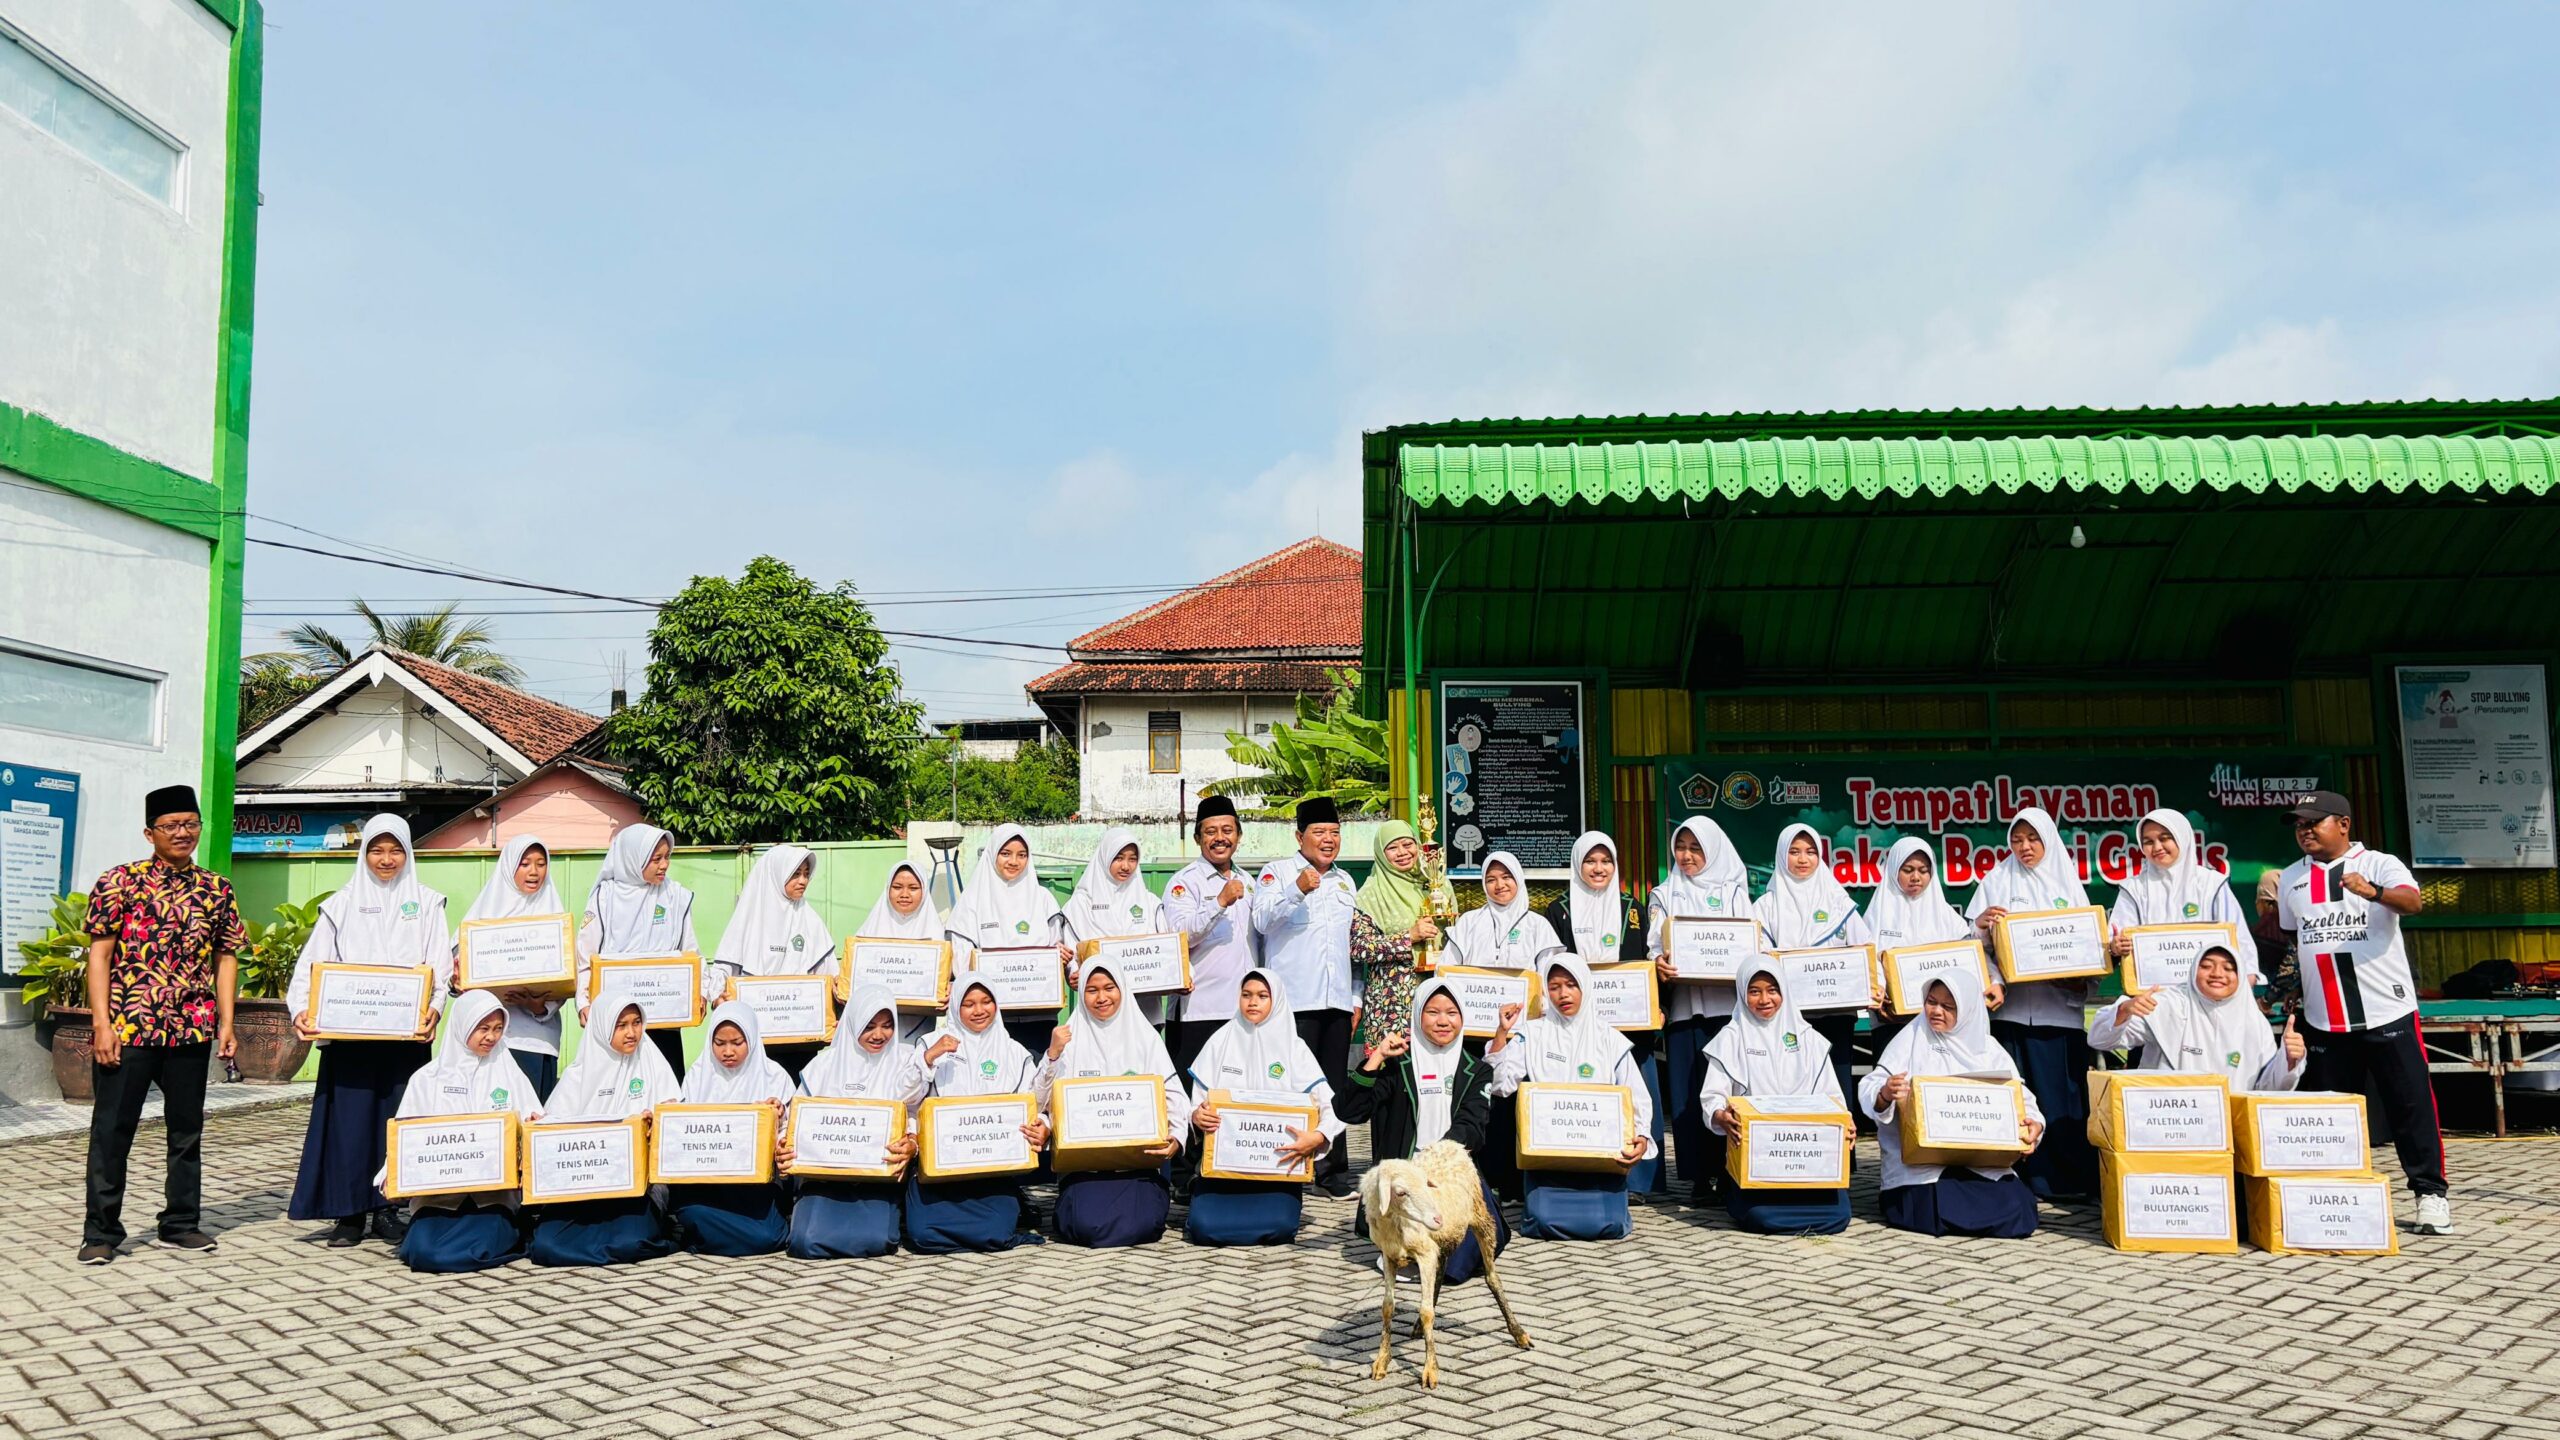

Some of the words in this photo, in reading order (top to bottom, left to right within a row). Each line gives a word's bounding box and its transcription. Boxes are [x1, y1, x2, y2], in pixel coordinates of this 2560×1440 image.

[2470, 692, 2491, 703] STOP
[2493, 692, 2531, 703] BULLYING
[2474, 705, 2529, 715] (Perundungan)
[1846, 777, 1993, 834] Tempat
[1995, 775, 2159, 829] Layanan
[233, 814, 303, 834] MAJA
[1693, 932, 1726, 941] JUARA
[1729, 932, 1735, 941] 2
[2032, 926, 2067, 938] JUARA
[2069, 925, 2076, 934] 2
[2326, 929, 2369, 942] PROGAM
[2040, 941, 2074, 952] TAHFIDZ
[2158, 941, 2195, 951] JUARA
[1121, 945, 1153, 958] JUARA
[1154, 945, 1161, 955] 2
[1700, 947, 1729, 956] SINGER
[879, 957, 906, 965] JUARA
[2048, 954, 2069, 962] PUTRI
[1002, 965, 1028, 973] JUARA
[1029, 964, 1034, 972] 2
[1123, 961, 1162, 973] KALIGRAFI
[1804, 962, 1838, 973] JUARA
[1839, 961, 1846, 970] 2
[1919, 960, 1951, 971] JUARA
[1953, 958, 1958, 967] 1
[1134, 974, 1153, 983] PUTRI
[1816, 978, 1837, 987] MTQ
[1465, 985, 1497, 995] JUARA
[1500, 986, 1505, 995] 1
[1620, 980, 1626, 990] 1
[355, 988, 380, 996] JUARA
[766, 994, 791, 1002] JUARA
[1596, 996, 1621, 1004] INGER
[351, 999, 376, 1007] BAHASA
[378, 1000, 412, 1008] INDONESIA
[1088, 1092, 1123, 1103] JUARA
[1125, 1092, 1132, 1101] 2
[1946, 1093, 1981, 1105] JUARA
[1984, 1095, 1990, 1105] 1
[1552, 1101, 1589, 1112] JUARA
[1592, 1102, 1598, 1112] 1
[2149, 1099, 2188, 1109] JUARA
[2191, 1099, 2197, 1109] 1
[1097, 1109, 1125, 1118] CATUR
[1939, 1111, 1967, 1120] TOLAK
[1968, 1111, 2002, 1121] PELURU
[820, 1115, 857, 1127] JUARA
[860, 1117, 866, 1127] 1
[958, 1115, 994, 1126] JUARA
[997, 1114, 1003, 1124] 1
[1551, 1118, 1575, 1127] BOLA
[1576, 1119, 1601, 1128] VOLLY
[2146, 1117, 2182, 1127] ATLETIK
[2183, 1117, 2204, 1126] LARI
[2285, 1116, 2325, 1127] JUARA
[2328, 1117, 2334, 1127] 1
[684, 1124, 723, 1135] JUARA
[725, 1123, 731, 1133] 1
[1238, 1121, 1274, 1133] JUARA
[1277, 1124, 1283, 1133] 1
[1961, 1124, 1983, 1133] PUTRI
[425, 1133, 465, 1146] JUARA
[470, 1133, 477, 1143] 1
[812, 1133, 847, 1143] PENCAK
[848, 1135, 872, 1143] SILAT
[952, 1133, 987, 1142] PENCAK
[989, 1131, 1010, 1140] SILAT
[1772, 1132, 1808, 1143] JUARA
[1812, 1132, 1818, 1142] 1
[2164, 1131, 2187, 1140] PUTRI
[2277, 1135, 2308, 1144] TOLAK
[2309, 1135, 2346, 1144] PELURU
[557, 1140, 597, 1152] JUARA
[600, 1140, 606, 1149] 1
[682, 1142, 707, 1151] TENIS
[708, 1141, 733, 1150] MEJA
[1235, 1139, 1258, 1148] BOLA
[829, 1147, 851, 1155] PUTRI
[971, 1147, 993, 1155] PUTRI
[1768, 1149, 1801, 1158] ATLETIK
[1803, 1149, 1823, 1158] LARI
[2301, 1150, 2324, 1159] PUTRI
[417, 1150, 485, 1164] BULUTANGKIS
[556, 1160, 582, 1170] TENIS
[584, 1158, 609, 1168] MEJA
[1784, 1163, 1806, 1171] PUTRI
[439, 1166, 463, 1176] PUTRI
[571, 1174, 594, 1182] PUTRI
[2150, 1185, 2190, 1196] JUARA
[2194, 1185, 2200, 1196] 1
[2308, 1194, 2350, 1206] JUARA
[2353, 1195, 2359, 1206] 1
[2143, 1203, 2210, 1213] BULUTANGKIS
[2165, 1218, 2189, 1227] PUTRI
[2319, 1214, 2351, 1224] CATUR
[2324, 1229, 2348, 1237] PUTRI
